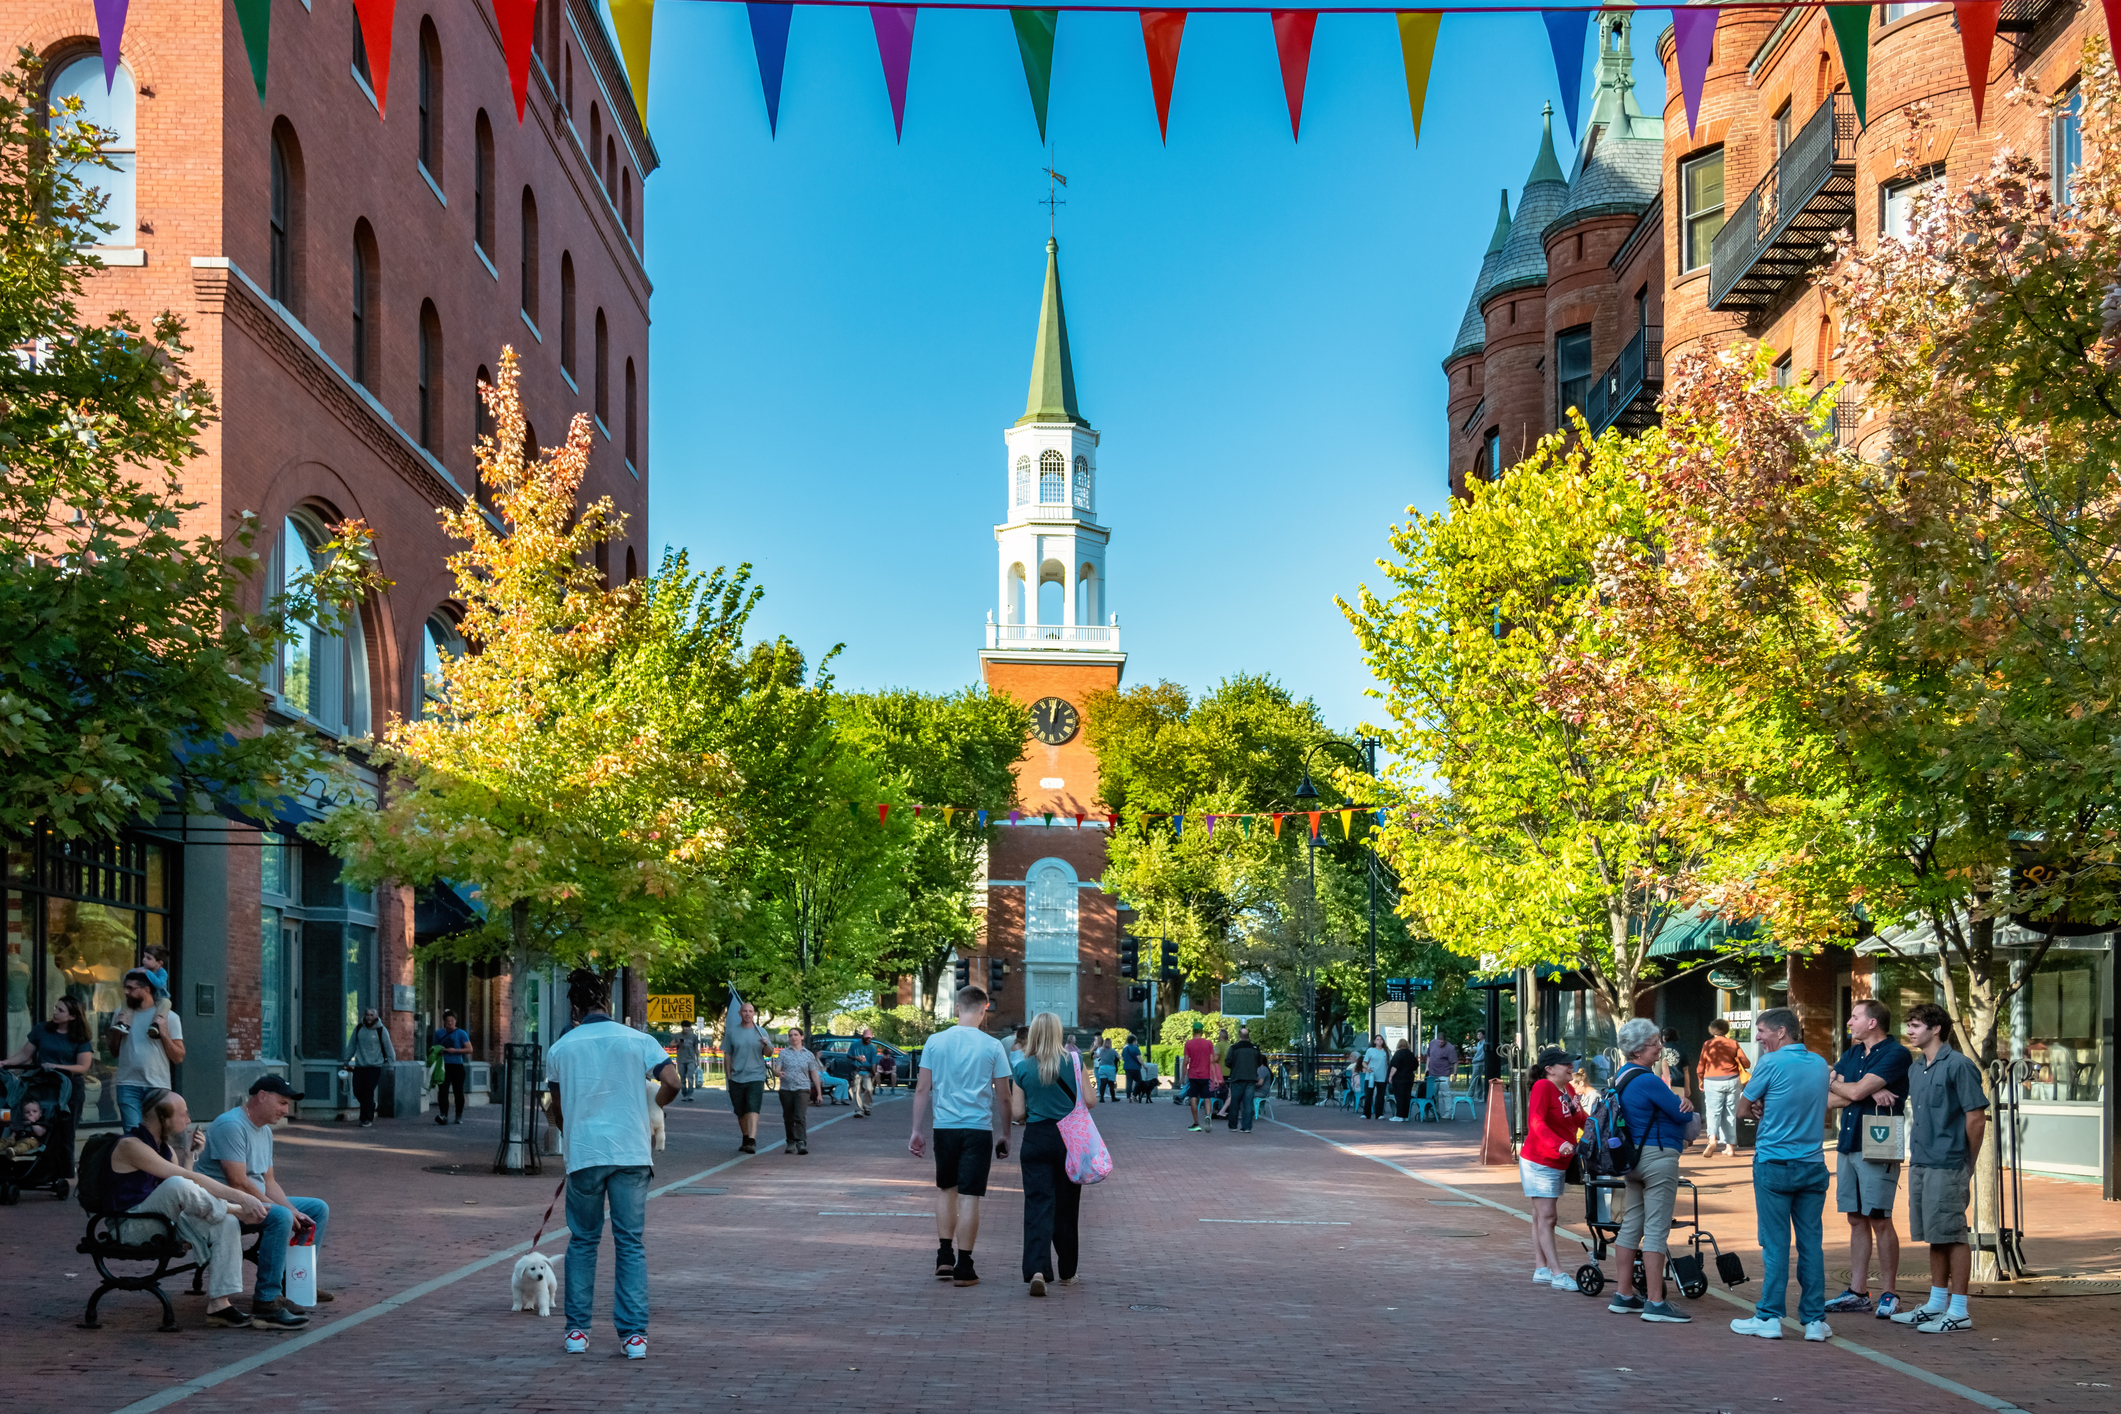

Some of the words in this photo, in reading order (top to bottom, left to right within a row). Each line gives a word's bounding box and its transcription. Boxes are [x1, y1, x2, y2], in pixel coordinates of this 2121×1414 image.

[661, 1005, 693, 1013] LIVES
[1873, 1128, 1886, 1140] V
[1895, 1117, 1904, 1159] bookstore
